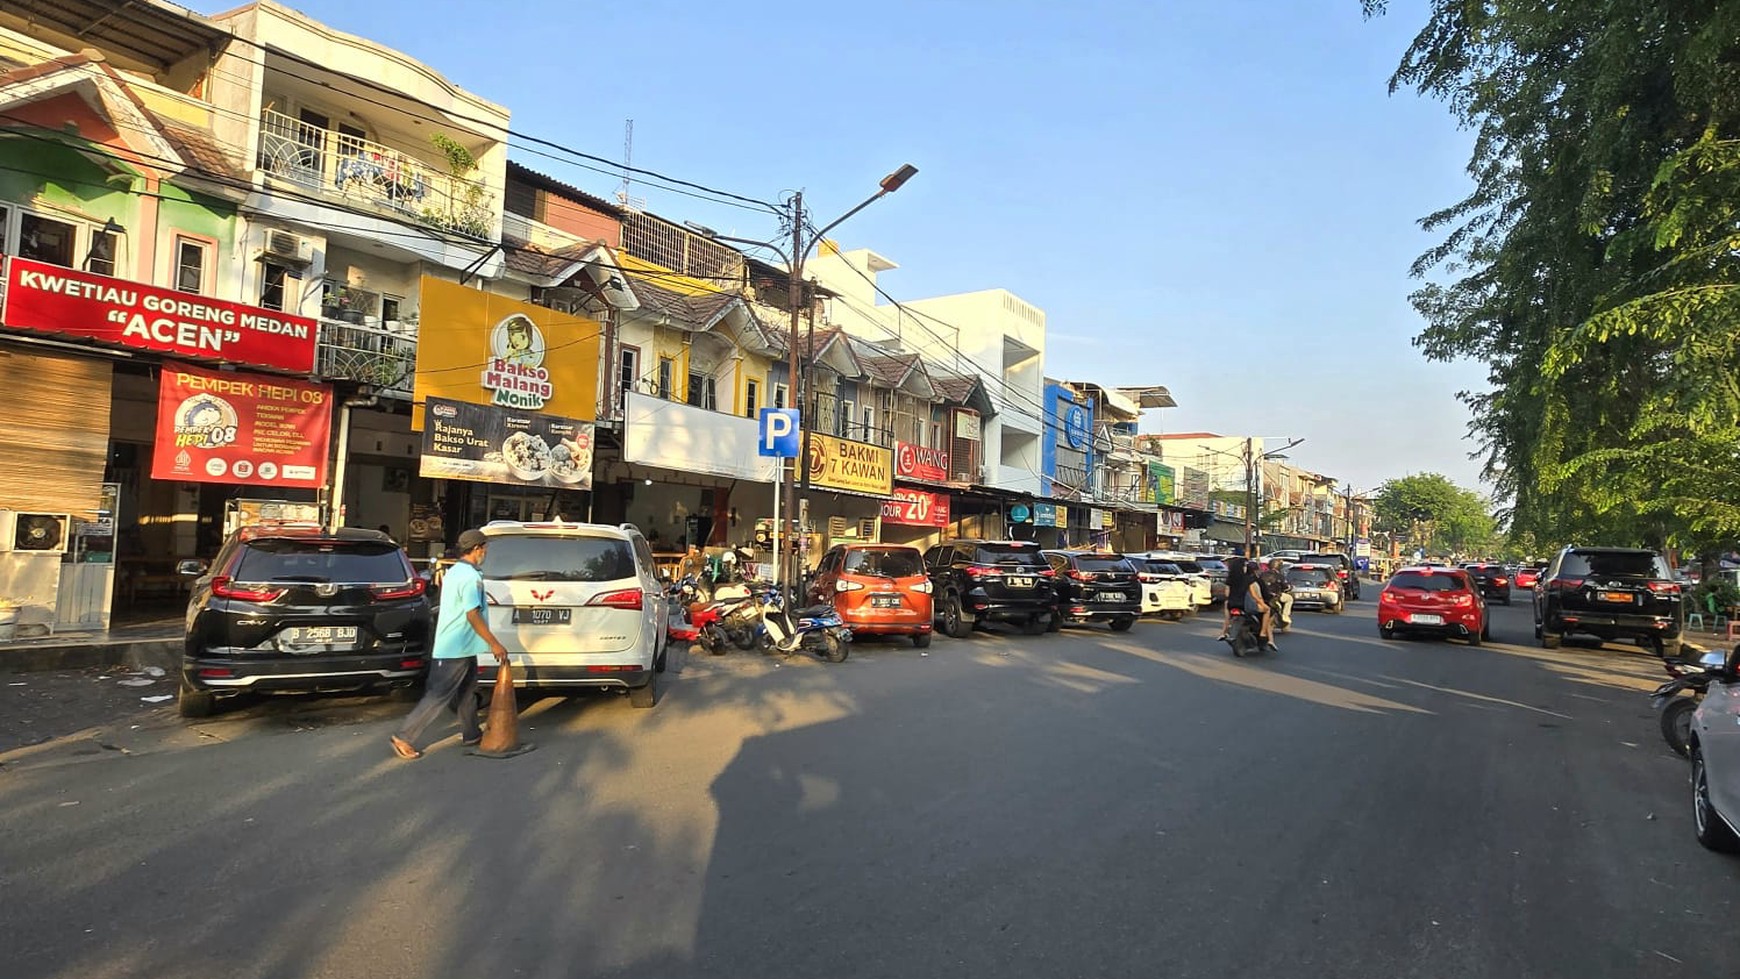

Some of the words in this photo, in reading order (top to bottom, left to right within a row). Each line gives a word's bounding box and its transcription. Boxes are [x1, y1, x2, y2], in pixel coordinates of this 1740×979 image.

[20, 270, 137, 307] KWETIAU
[143, 290, 235, 325] GORENG
[240, 314, 308, 339] MEDAN
[495, 358, 546, 380] Bakso
[176, 372, 253, 397] PEMPEK
[258, 384, 297, 402] HEPI
[301, 390, 323, 404] 08
[487, 371, 550, 397] Malang
[496, 390, 541, 407] Nonik
[211, 426, 237, 443] 08
[435, 421, 473, 436] Rajanya
[766, 413, 791, 449] P
[175, 432, 209, 448] HEPI
[433, 443, 462, 454] Kasar
[434, 433, 464, 445] Bakso
[466, 437, 489, 447] Urat
[840, 443, 878, 463] BAKMI
[916, 447, 948, 470] WANG
[831, 459, 838, 474] 7
[842, 460, 885, 481] KAWAN
[531, 610, 552, 620] 1070
